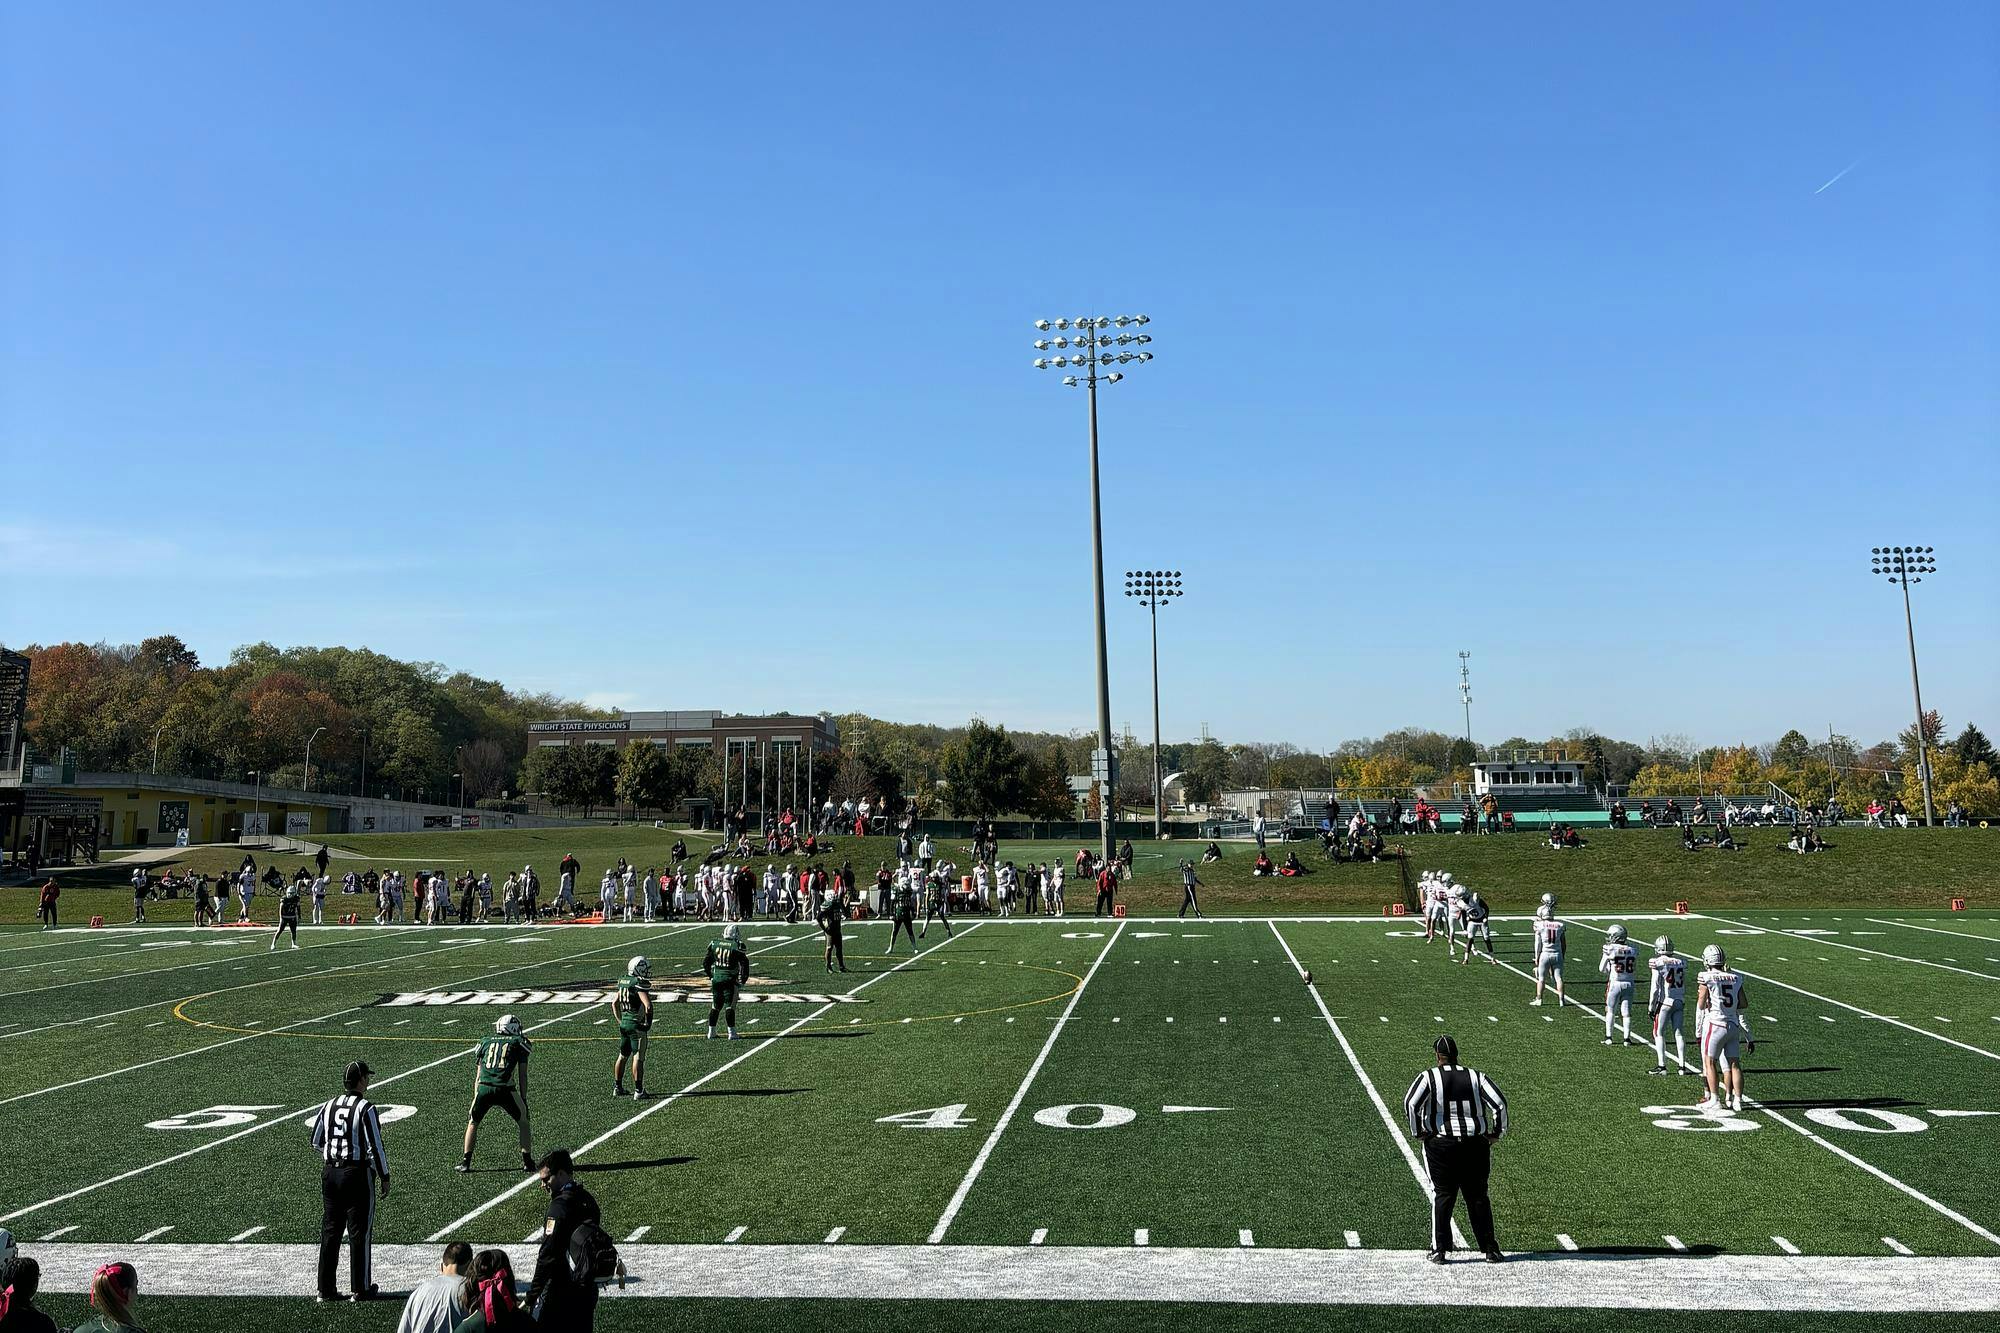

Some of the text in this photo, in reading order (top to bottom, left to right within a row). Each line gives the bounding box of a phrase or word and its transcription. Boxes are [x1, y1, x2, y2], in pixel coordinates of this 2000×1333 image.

[530, 723, 559, 731] WRIGHT
[584, 722, 627, 730] PHYSICIANS
[1116, 906, 1125, 916] 40
[1394, 904, 1404, 914] 30
[1678, 902, 1688, 912] 20
[1954, 900, 1965, 909] 10
[1547, 929, 1557, 944] 11
[1665, 967, 1684, 989] 43
[1721, 984, 1734, 1008] 5
[333, 1107, 349, 1136] S
[875, 1103, 1137, 1129] 40
[1640, 1104, 1929, 1133] 30
